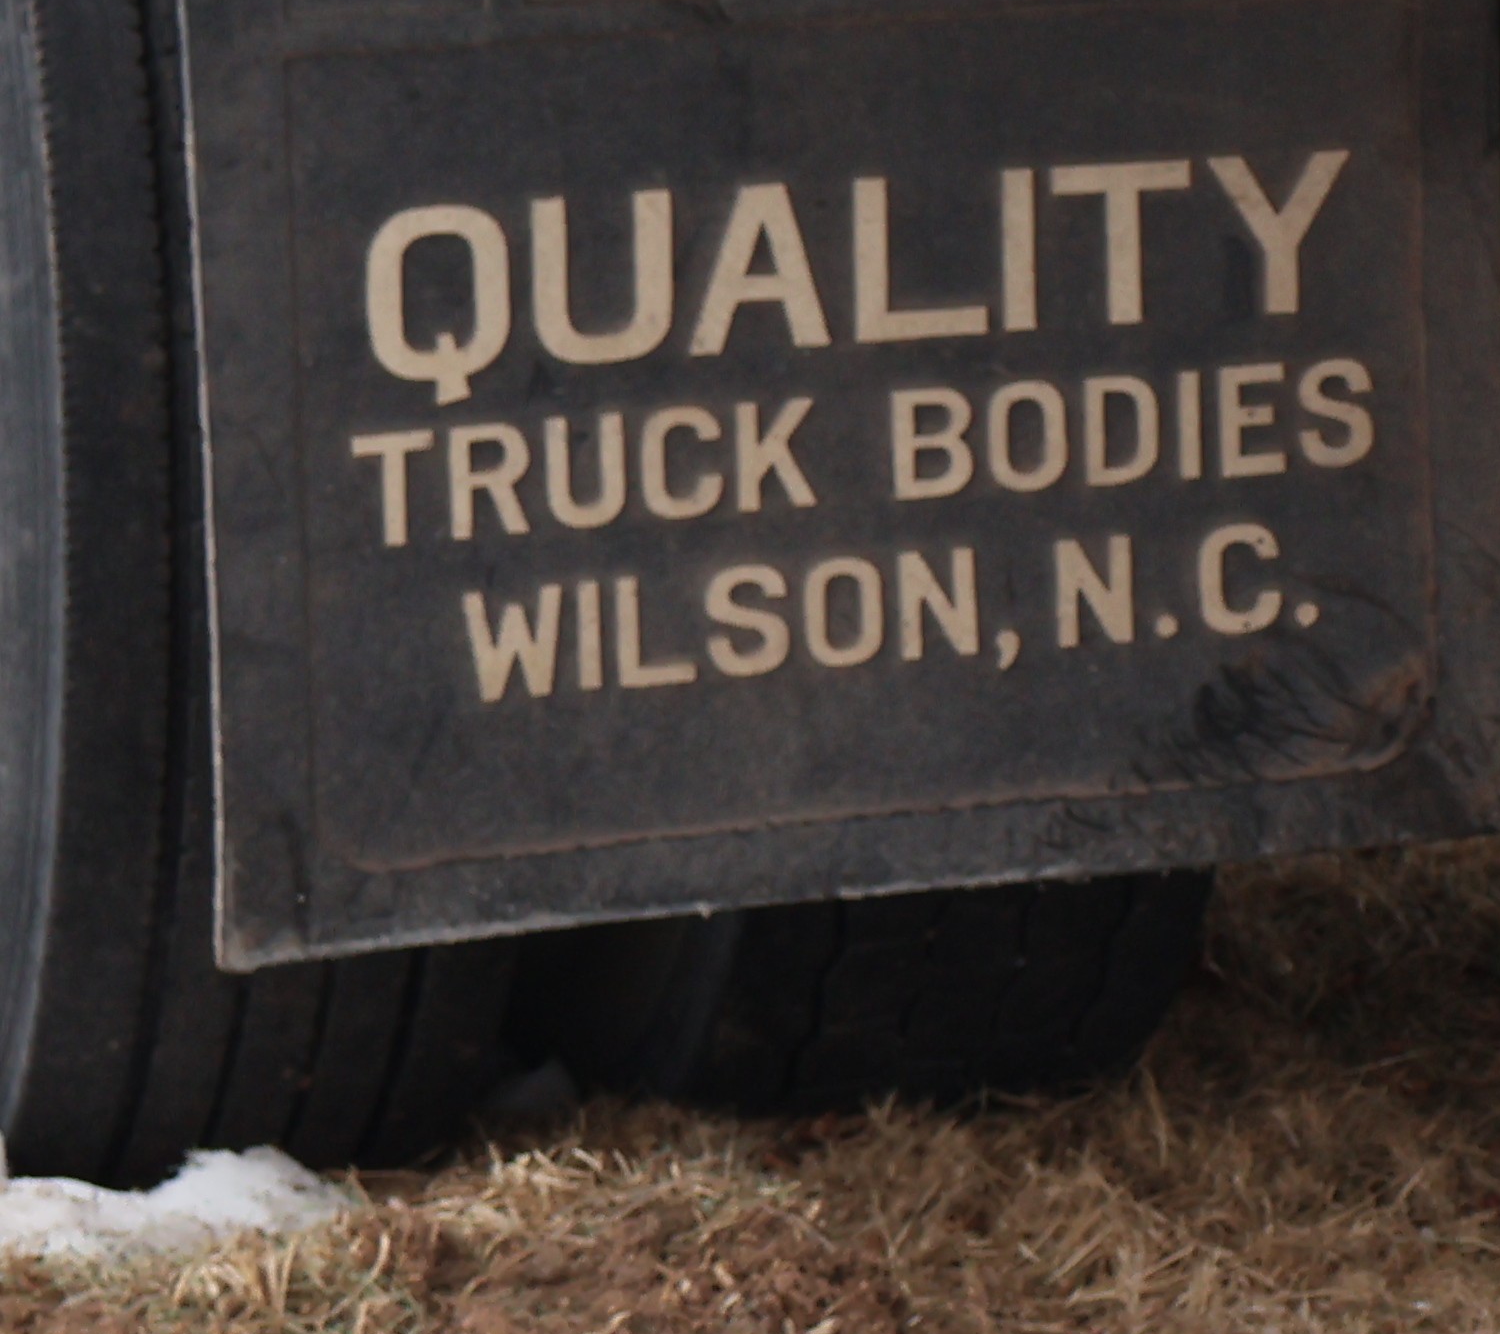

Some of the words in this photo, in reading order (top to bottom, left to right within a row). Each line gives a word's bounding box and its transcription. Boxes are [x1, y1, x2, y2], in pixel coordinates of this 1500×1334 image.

[364, 150, 1348, 405] QUALITY
[349, 396, 817, 547] TRUCK
[889, 358, 1373, 501] BODIES
[461, 545, 1019, 703] WILSON,
[1054, 523, 1318, 648] N.C.
